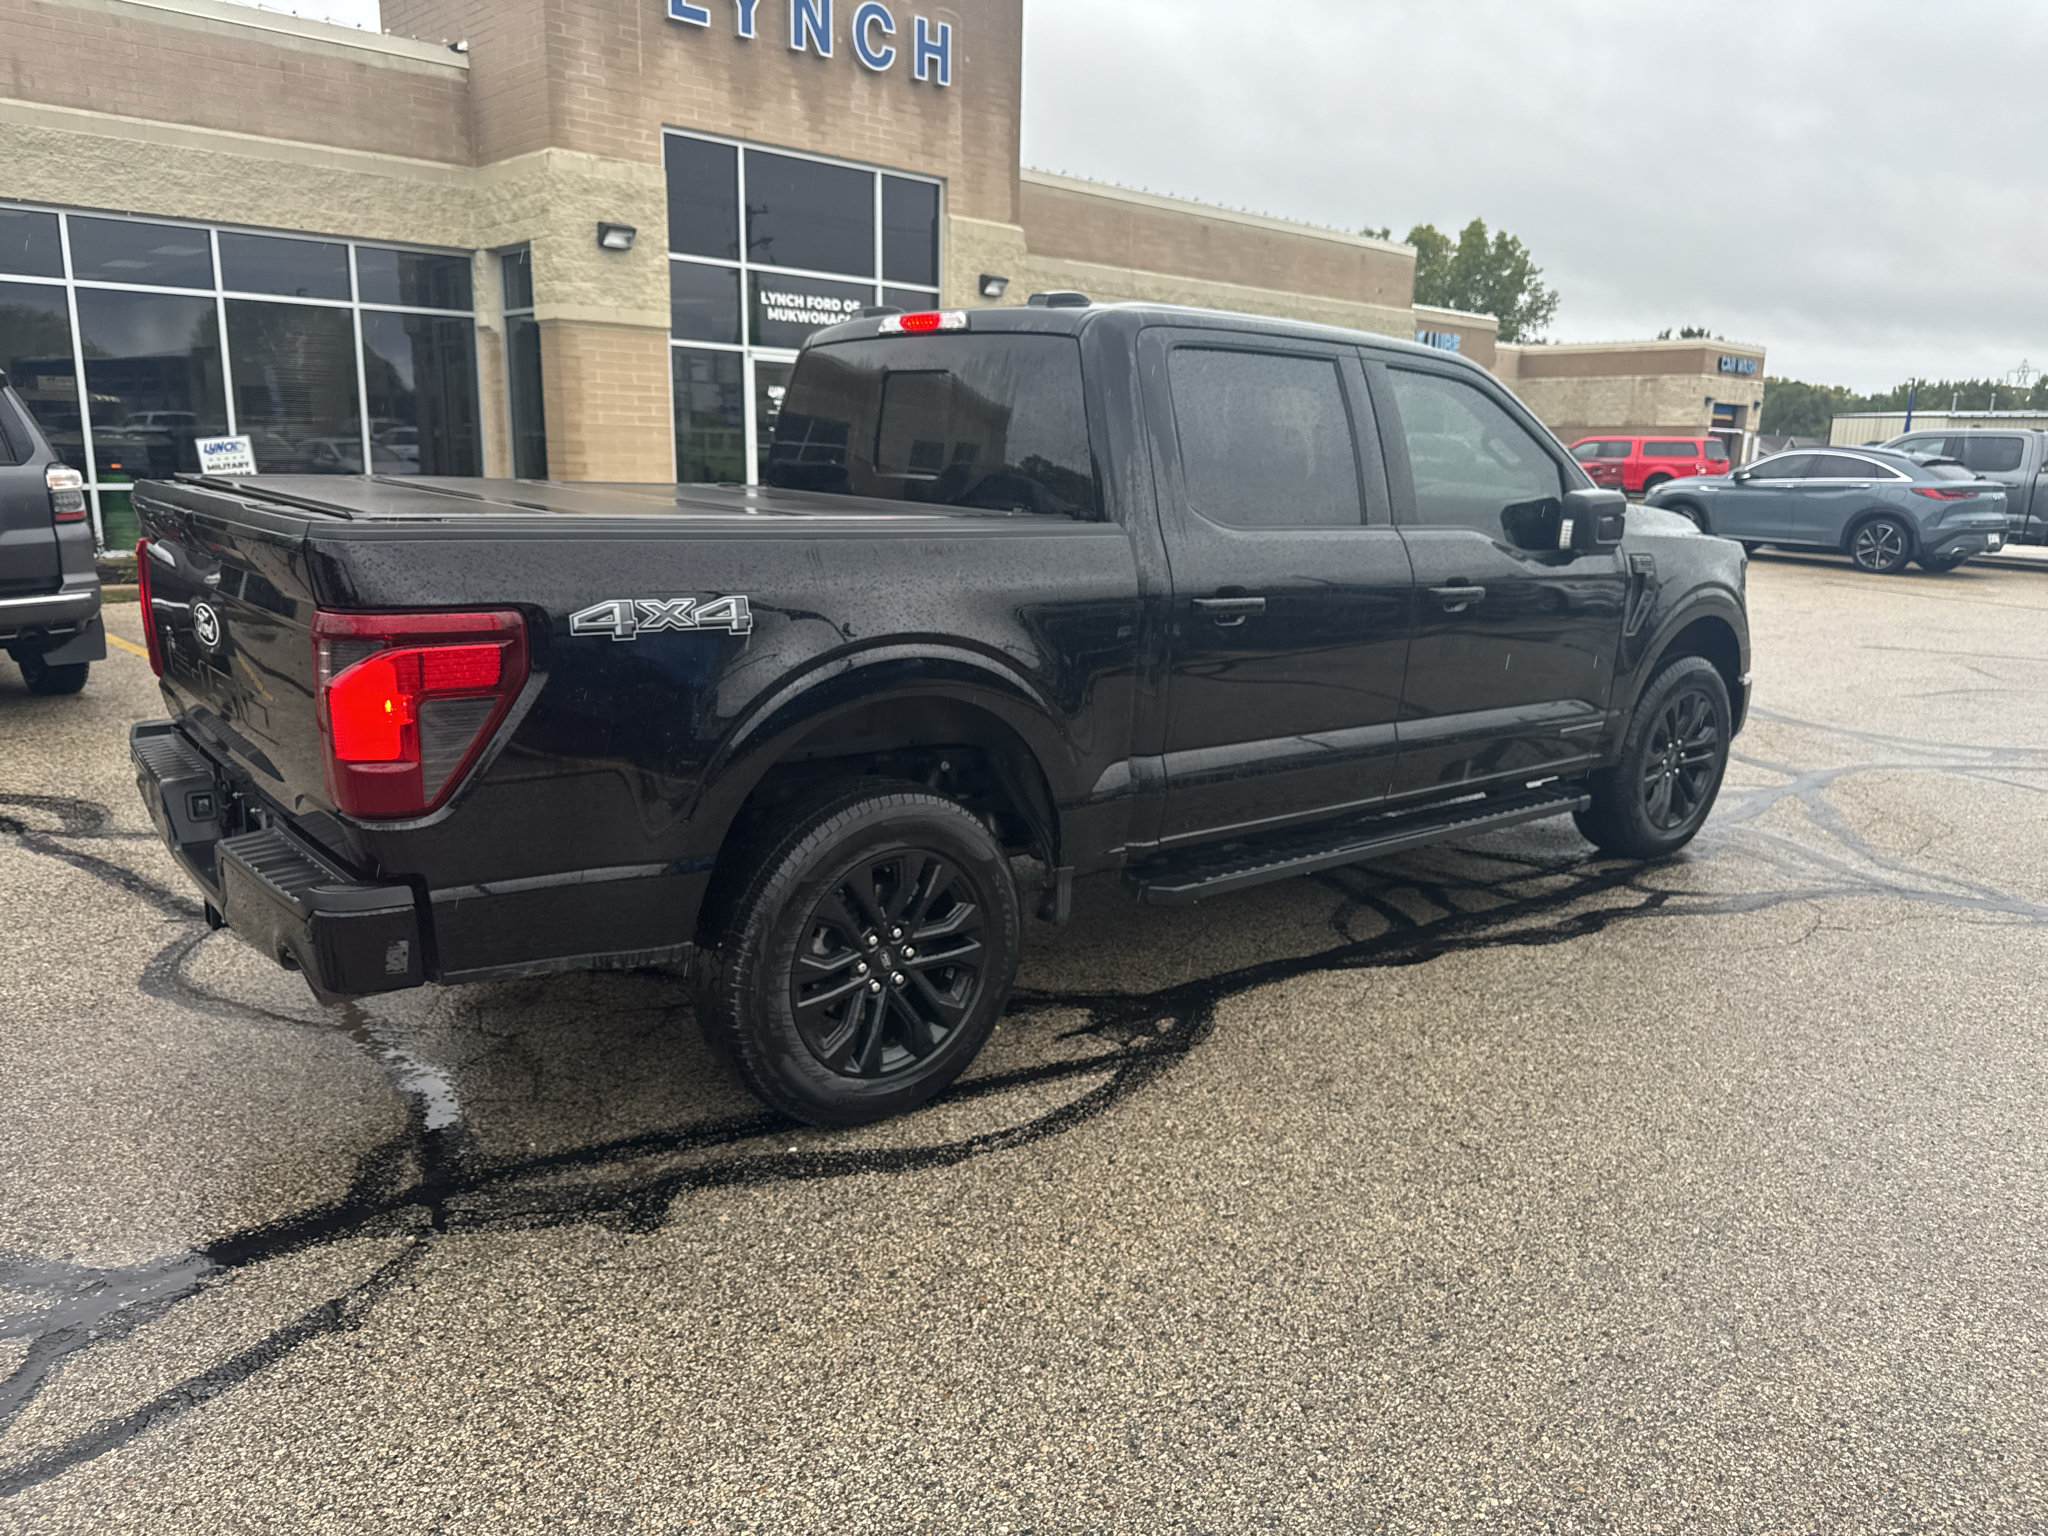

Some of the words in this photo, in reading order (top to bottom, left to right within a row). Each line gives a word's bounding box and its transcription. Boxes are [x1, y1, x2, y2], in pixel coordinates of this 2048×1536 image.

[667, 0, 952, 87] YNCH
[760, 290, 805, 308] LYNCH
[806, 295, 842, 312] FORD
[842, 298, 861, 313] OF
[1721, 356, 1736, 372] CAR
[1737, 359, 1756, 374] WASH
[206, 461, 249, 471] MILITARY
